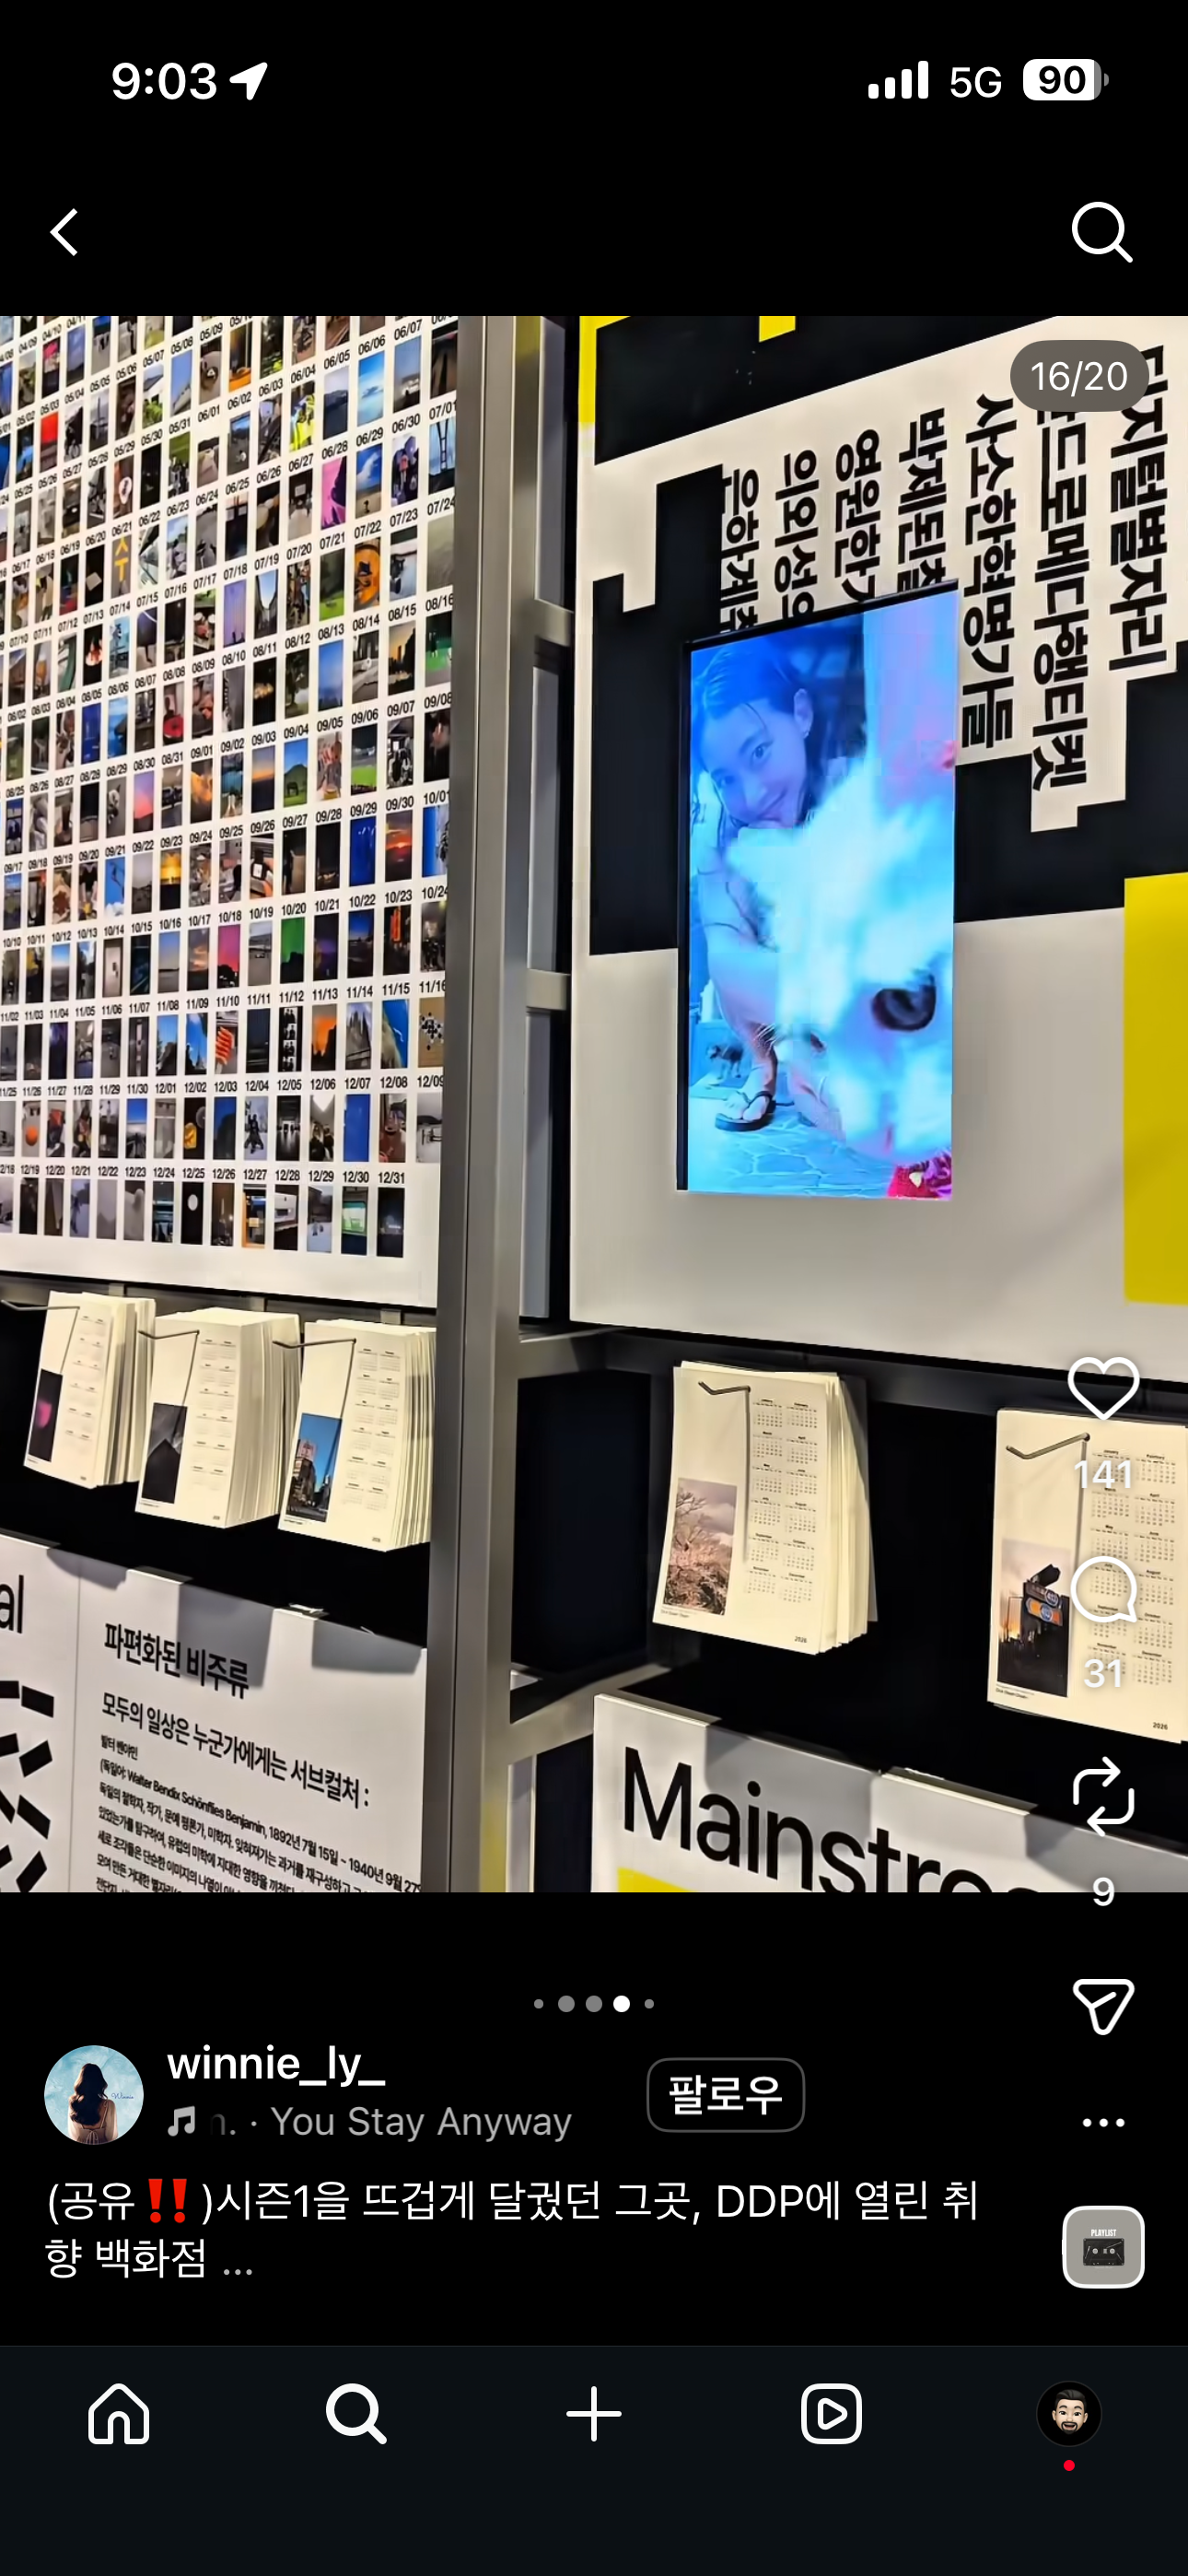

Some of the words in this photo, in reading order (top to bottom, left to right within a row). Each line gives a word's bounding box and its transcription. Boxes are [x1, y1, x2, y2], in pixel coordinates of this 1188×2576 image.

[394, 319, 422, 340] 06/07
[358, 334, 385, 355] 06/06
[324, 349, 350, 369] 06/05
[291, 364, 315, 383] 06/04
[259, 378, 283, 396] 06/03
[228, 392, 251, 410] 06/02
[392, 413, 420, 433] 06/30
[356, 427, 383, 446] 06/29
[322, 440, 348, 459] 06/28
[289, 453, 313, 472] 06/27
[257, 465, 281, 483] 06/26
[390, 509, 418, 527] 07/23
[355, 520, 381, 538] 07/22
[320, 533, 344, 549] 07/21
[287, 543, 311, 560] 07/20
[254, 553, 279, 570] 07/19
[224, 564, 247, 580] 07/18
[962, 393, 1017, 748] 사소한혁명가들
[1032, 412, 1090, 791] 드로메다행티켓
[389, 603, 416, 621] 08/15
[353, 614, 379, 631] 08/14
[319, 623, 344, 640] 08/13
[285, 633, 310, 649] 08/12
[253, 642, 276, 658] 08/11
[352, 708, 379, 724] 09/06
[387, 700, 414, 717] 09/07
[284, 724, 309, 739] 09/04
[317, 716, 343, 732] 09/05
[252, 731, 276, 746] 09/03
[350, 802, 377, 817] 09/29
[386, 796, 413, 811] 09/30
[283, 814, 308, 828] 09/27
[316, 808, 342, 823] 09/28
[250, 820, 274, 833] 09/26
[350, 894, 376, 907] 10/22
[385, 890, 412, 903] 10/23
[250, 907, 274, 919] 10/19
[282, 903, 306, 916] 10/20
[315, 899, 339, 912] 10/21
[280, 990, 304, 1002] 11/12
[313, 988, 338, 1001] 11/13
[347, 986, 373, 998] 11/14
[383, 982, 410, 995] 11/15
[248, 993, 270, 1004] 11/11
[246, 1080, 269, 1091] 12/04
[278, 1079, 302, 1091] 12/05
[311, 1078, 335, 1090] 12/06
[344, 1078, 370, 1089] 12/07
[380, 1076, 407, 1088] 12/08
[243, 1169, 267, 1179] 12/27
[275, 1169, 300, 1181] 12/28
[309, 1170, 334, 1182] 12/29
[343, 1171, 368, 1183] 12/30
[379, 1172, 404, 1184] 12/31
[104, 1623, 181, 1678] 파편화된
[187, 1647, 249, 1699] 비주류
[1153, 1721, 1169, 1731] 2026
[102, 1692, 143, 1729] 모두의
[147, 1706, 190, 1745] 일상은
[193, 1724, 287, 1781] 누군가에게는
[291, 1760, 359, 1809] 서브컬처
[127, 1769, 153, 1789] Walter
[153, 1780, 181, 1799] Bendix
[269, 1826, 301, 1851] 1892년
[319, 1845, 338, 1866] 15일
[349, 1857, 384, 1884] 1940년
[385, 1872, 402, 1892] 9월
[404, 1879, 422, 1892] 27
